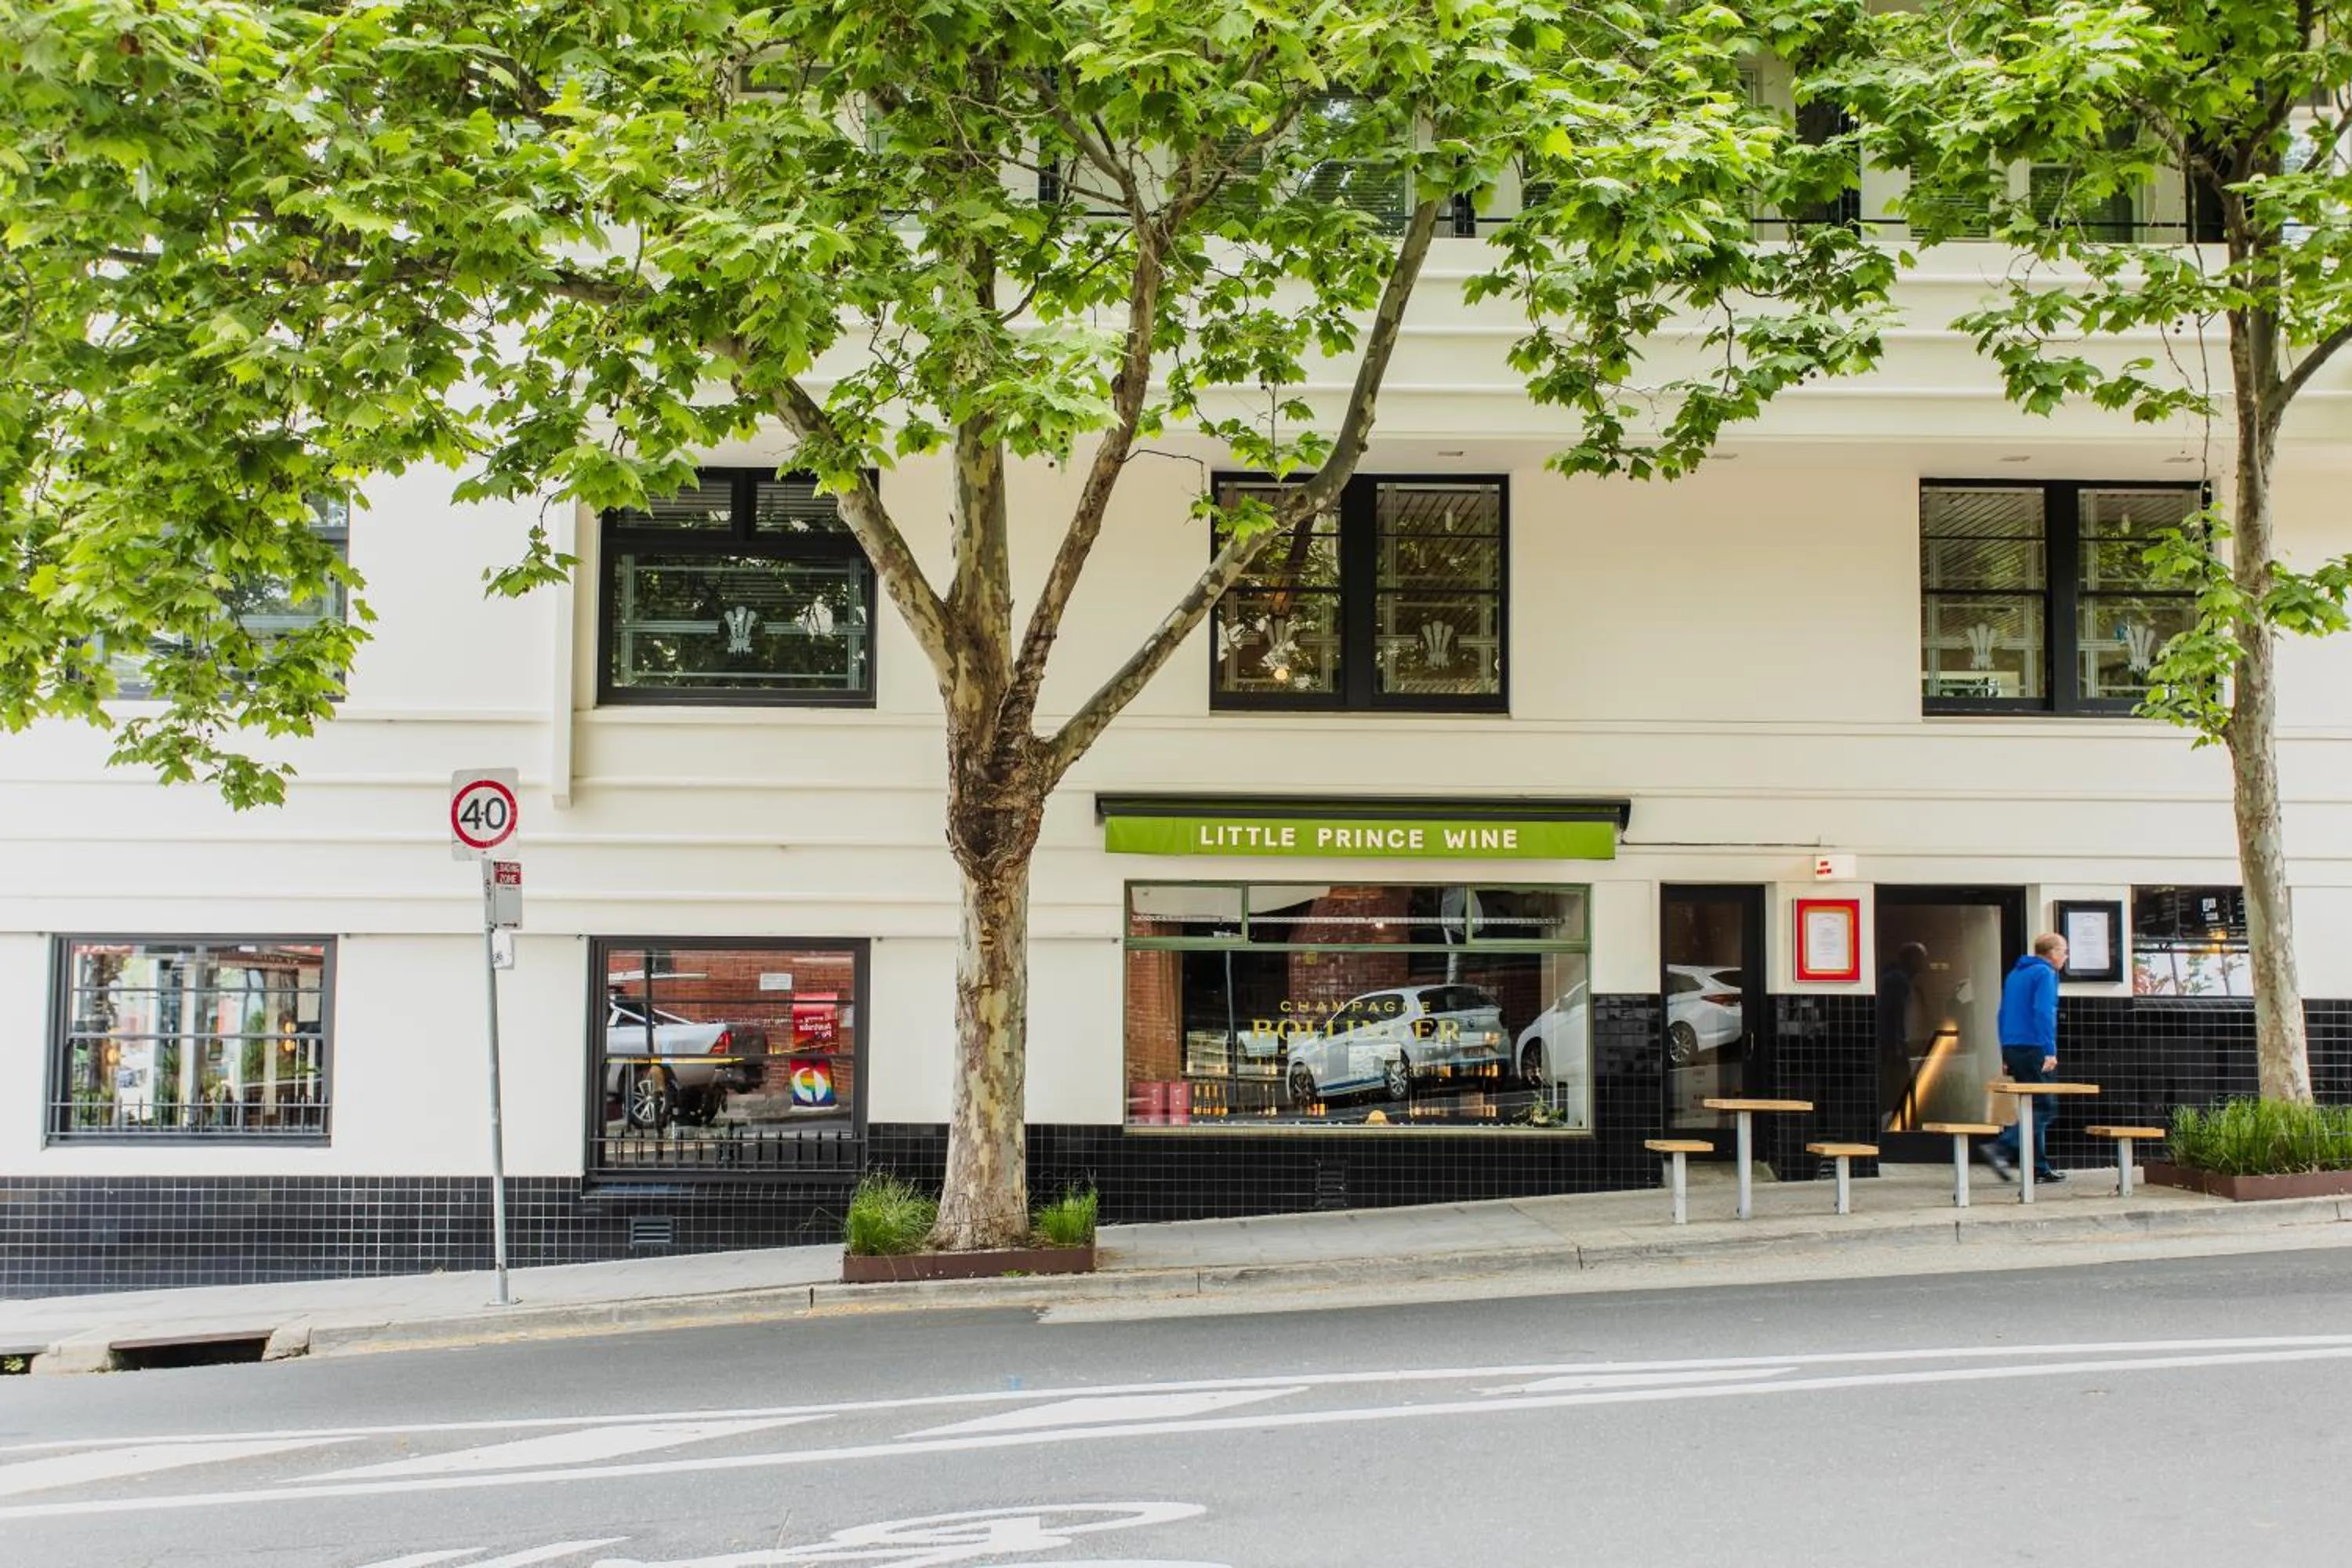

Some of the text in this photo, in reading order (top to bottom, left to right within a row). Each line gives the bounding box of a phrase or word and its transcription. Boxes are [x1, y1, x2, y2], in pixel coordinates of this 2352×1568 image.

[459, 797, 506, 830] 40
[1200, 826, 1519, 849] LITTLE PRINCE WINE
[1253, 1018, 1461, 1042] BOLLINER
